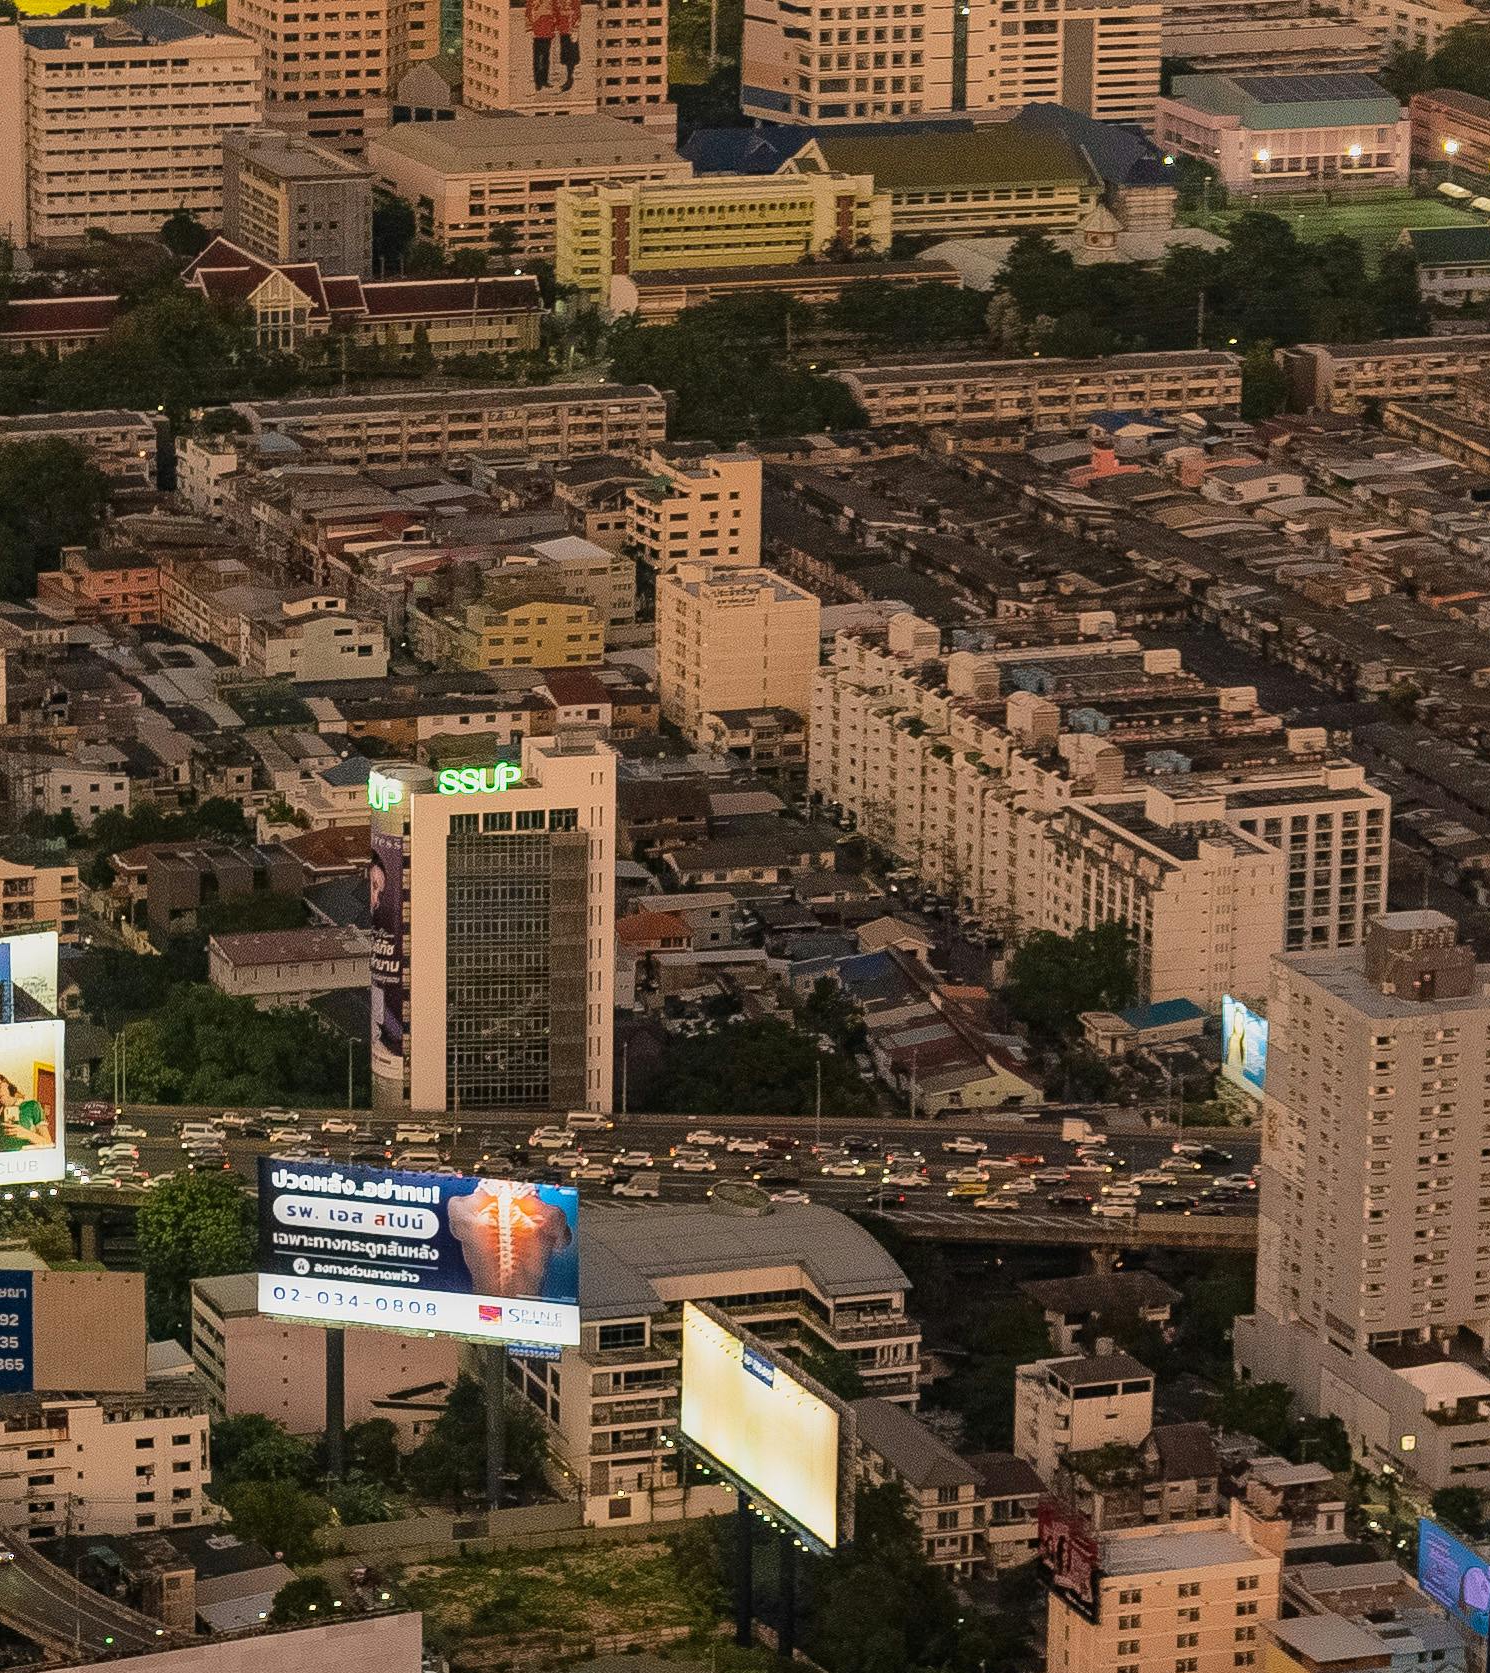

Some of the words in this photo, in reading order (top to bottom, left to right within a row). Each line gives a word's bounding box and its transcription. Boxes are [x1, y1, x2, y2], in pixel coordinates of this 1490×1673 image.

[439, 762, 522, 796] SSUP
[286, 1205, 318, 1219] รพ.
[330, 1209, 363, 1224] เอส
[374, 1213, 424, 1230] สไปน์
[273, 1232, 439, 1260] เฉพาะทางกระดูกสันหลัง
[273, 1287, 437, 1316] 02-034-0808
